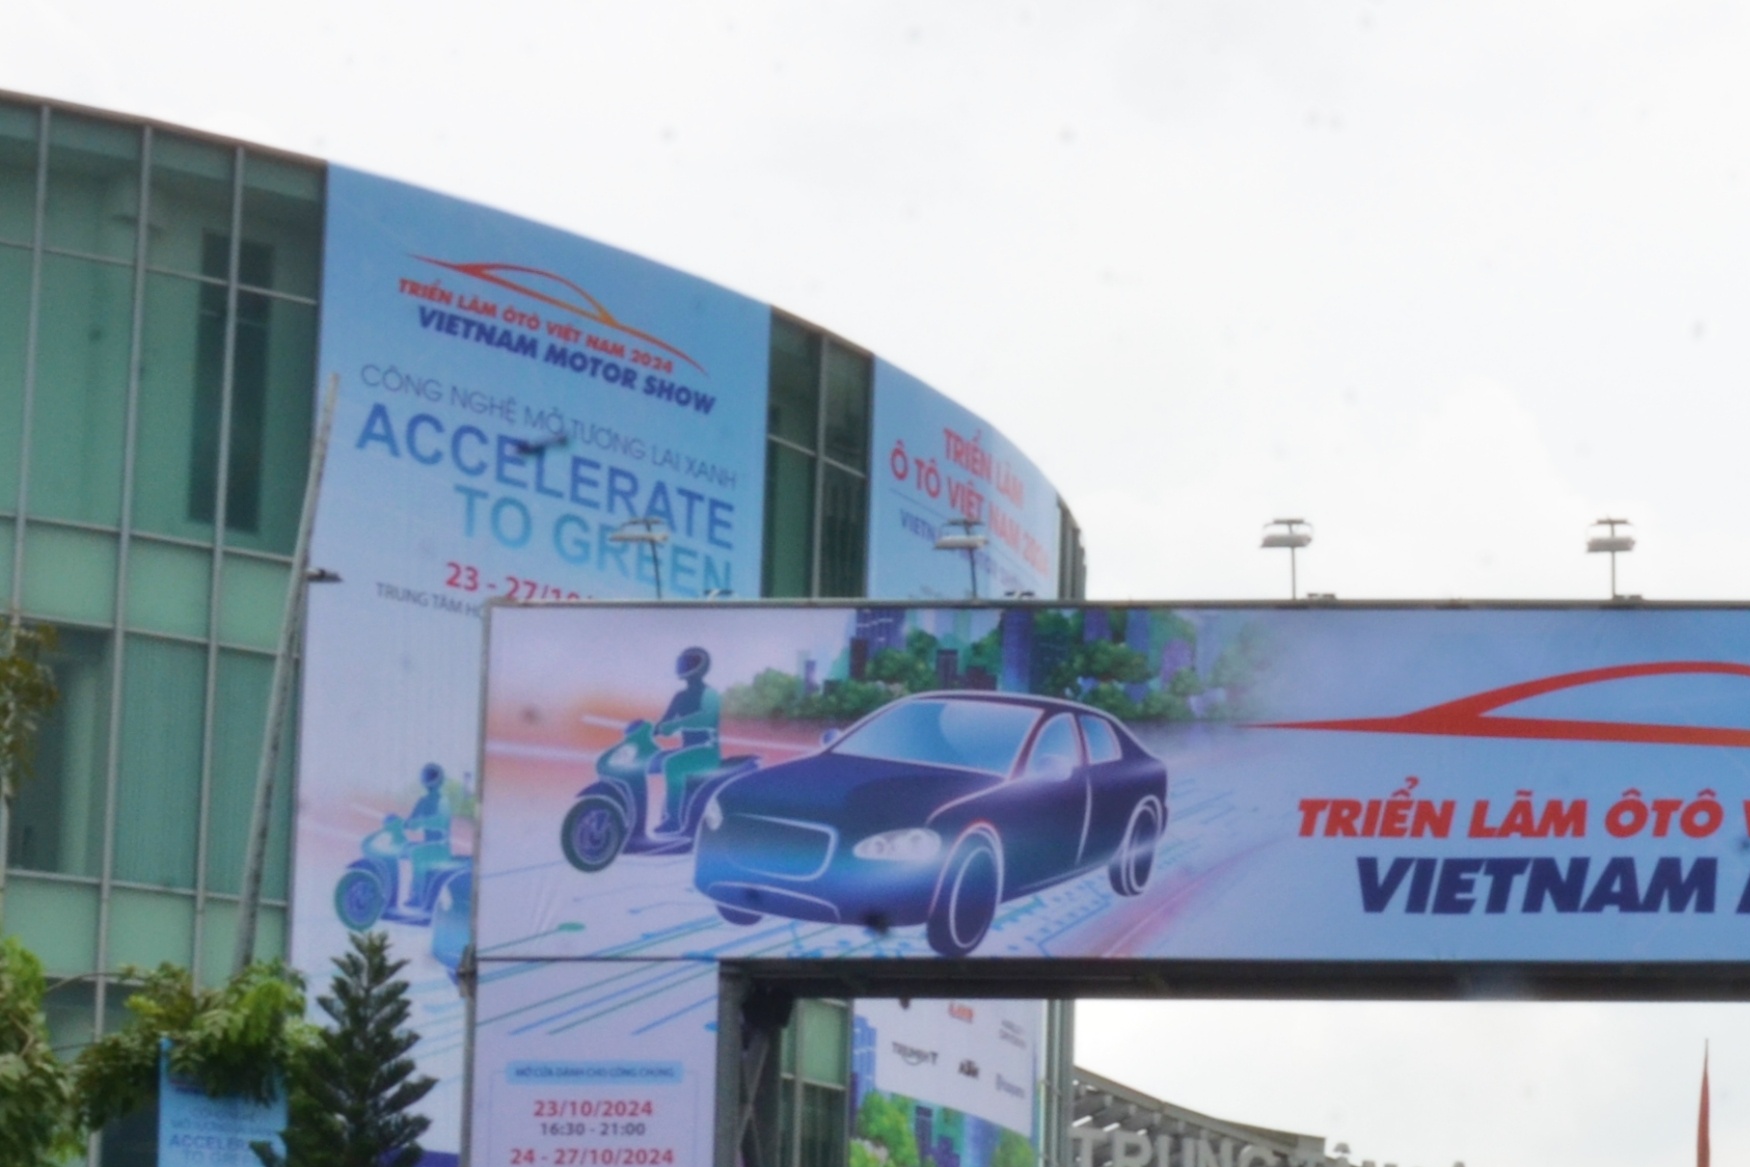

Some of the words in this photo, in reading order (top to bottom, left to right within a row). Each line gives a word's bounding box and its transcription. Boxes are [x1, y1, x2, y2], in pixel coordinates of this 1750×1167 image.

[417, 305, 538, 358] VIETNAM
[544, 343, 639, 390] MOTOR
[643, 374, 717, 415] SHOW
[586, 333, 626, 358] NAM
[629, 347, 674, 374] 2024
[360, 364, 443, 402] CÔNG
[651, 438, 680, 470] LAI
[684, 448, 739, 490] XANH
[355, 402, 735, 550] ACCELERATE
[890, 439, 908, 481] Ô
[914, 456, 941, 498] TÔ
[453, 484, 532, 549] TO
[553, 512, 733, 599] GREEN
[445, 561, 479, 592] 23
[1297, 776, 1456, 838] TRIỂN
[1467, 790, 1587, 838] LÃM
[1605, 787, 1723, 838] ÔTÔ
[1356, 856, 1718, 914] VIETNAM
[533, 1100, 653, 1117] 23/10/2024
[540, 1122, 585, 1136] 16:30
[600, 1122, 646, 1136] 21:00
[510, 1149, 535, 1165] 24
[554, 1149, 674, 1165] 27/10/2024
